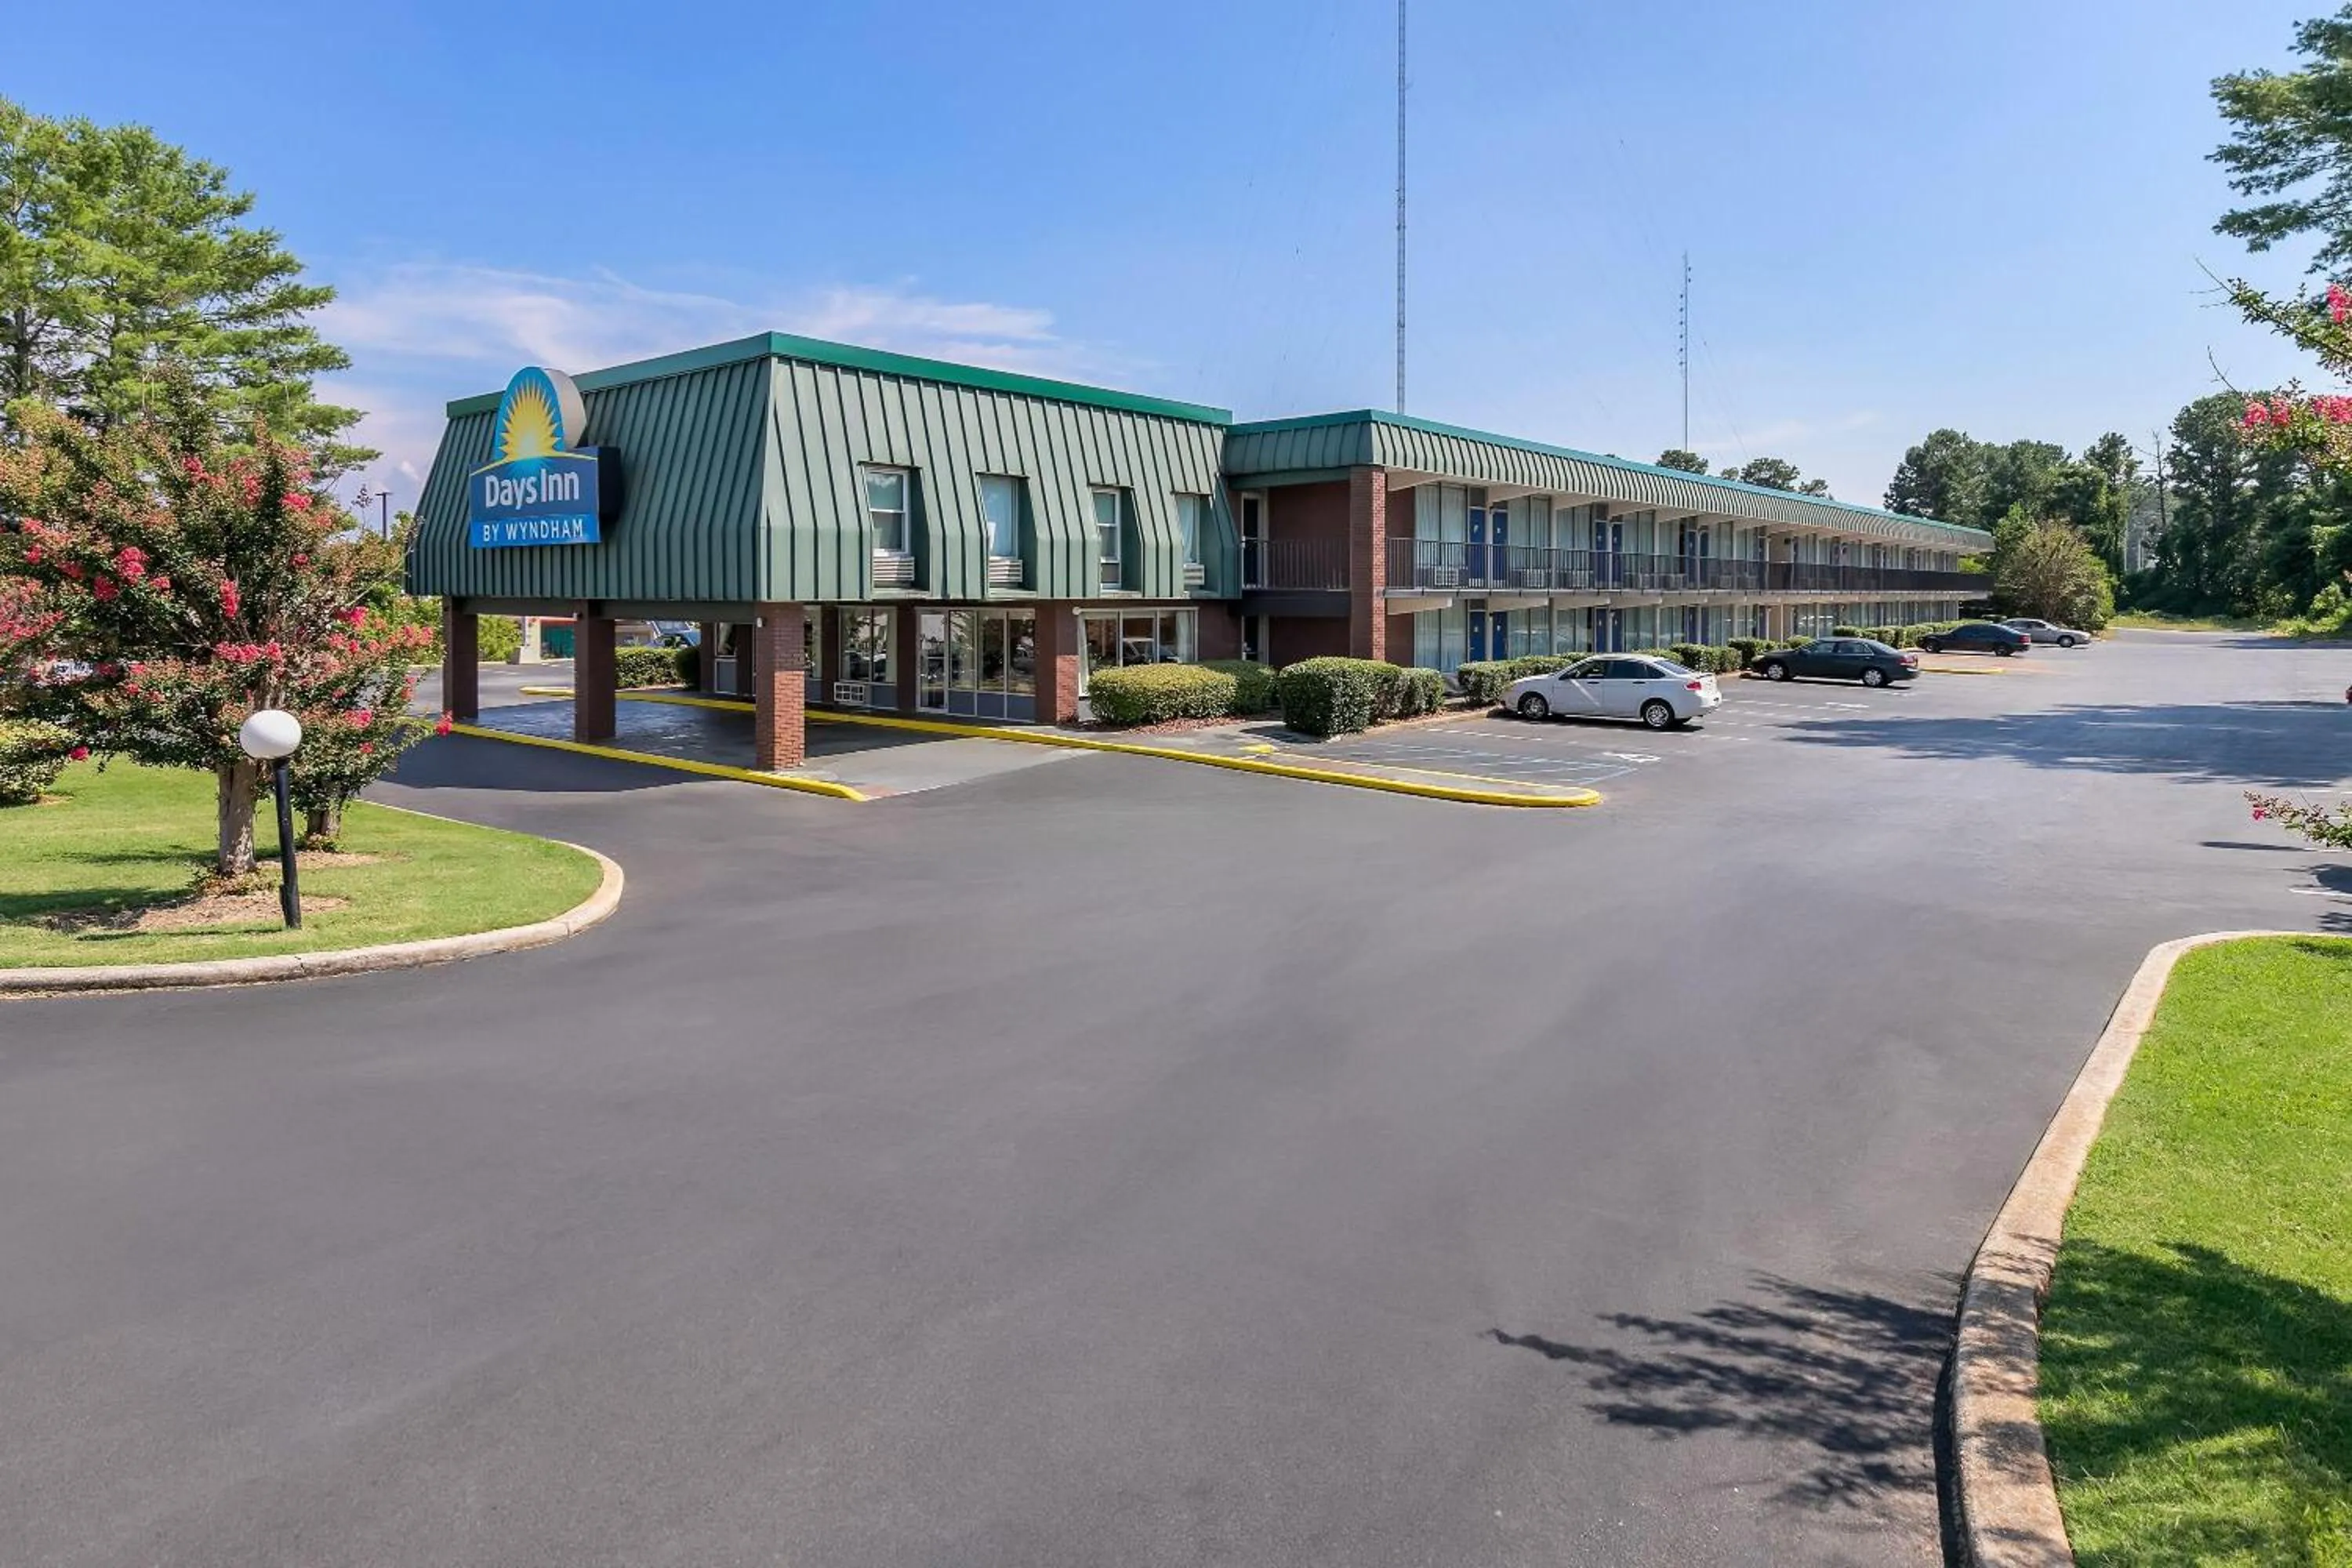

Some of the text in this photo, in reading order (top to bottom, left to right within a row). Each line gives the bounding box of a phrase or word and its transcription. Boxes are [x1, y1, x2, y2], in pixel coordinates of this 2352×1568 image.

[485, 468, 579, 510] Days Inn
[483, 518, 583, 542] BY WYNDHAM
